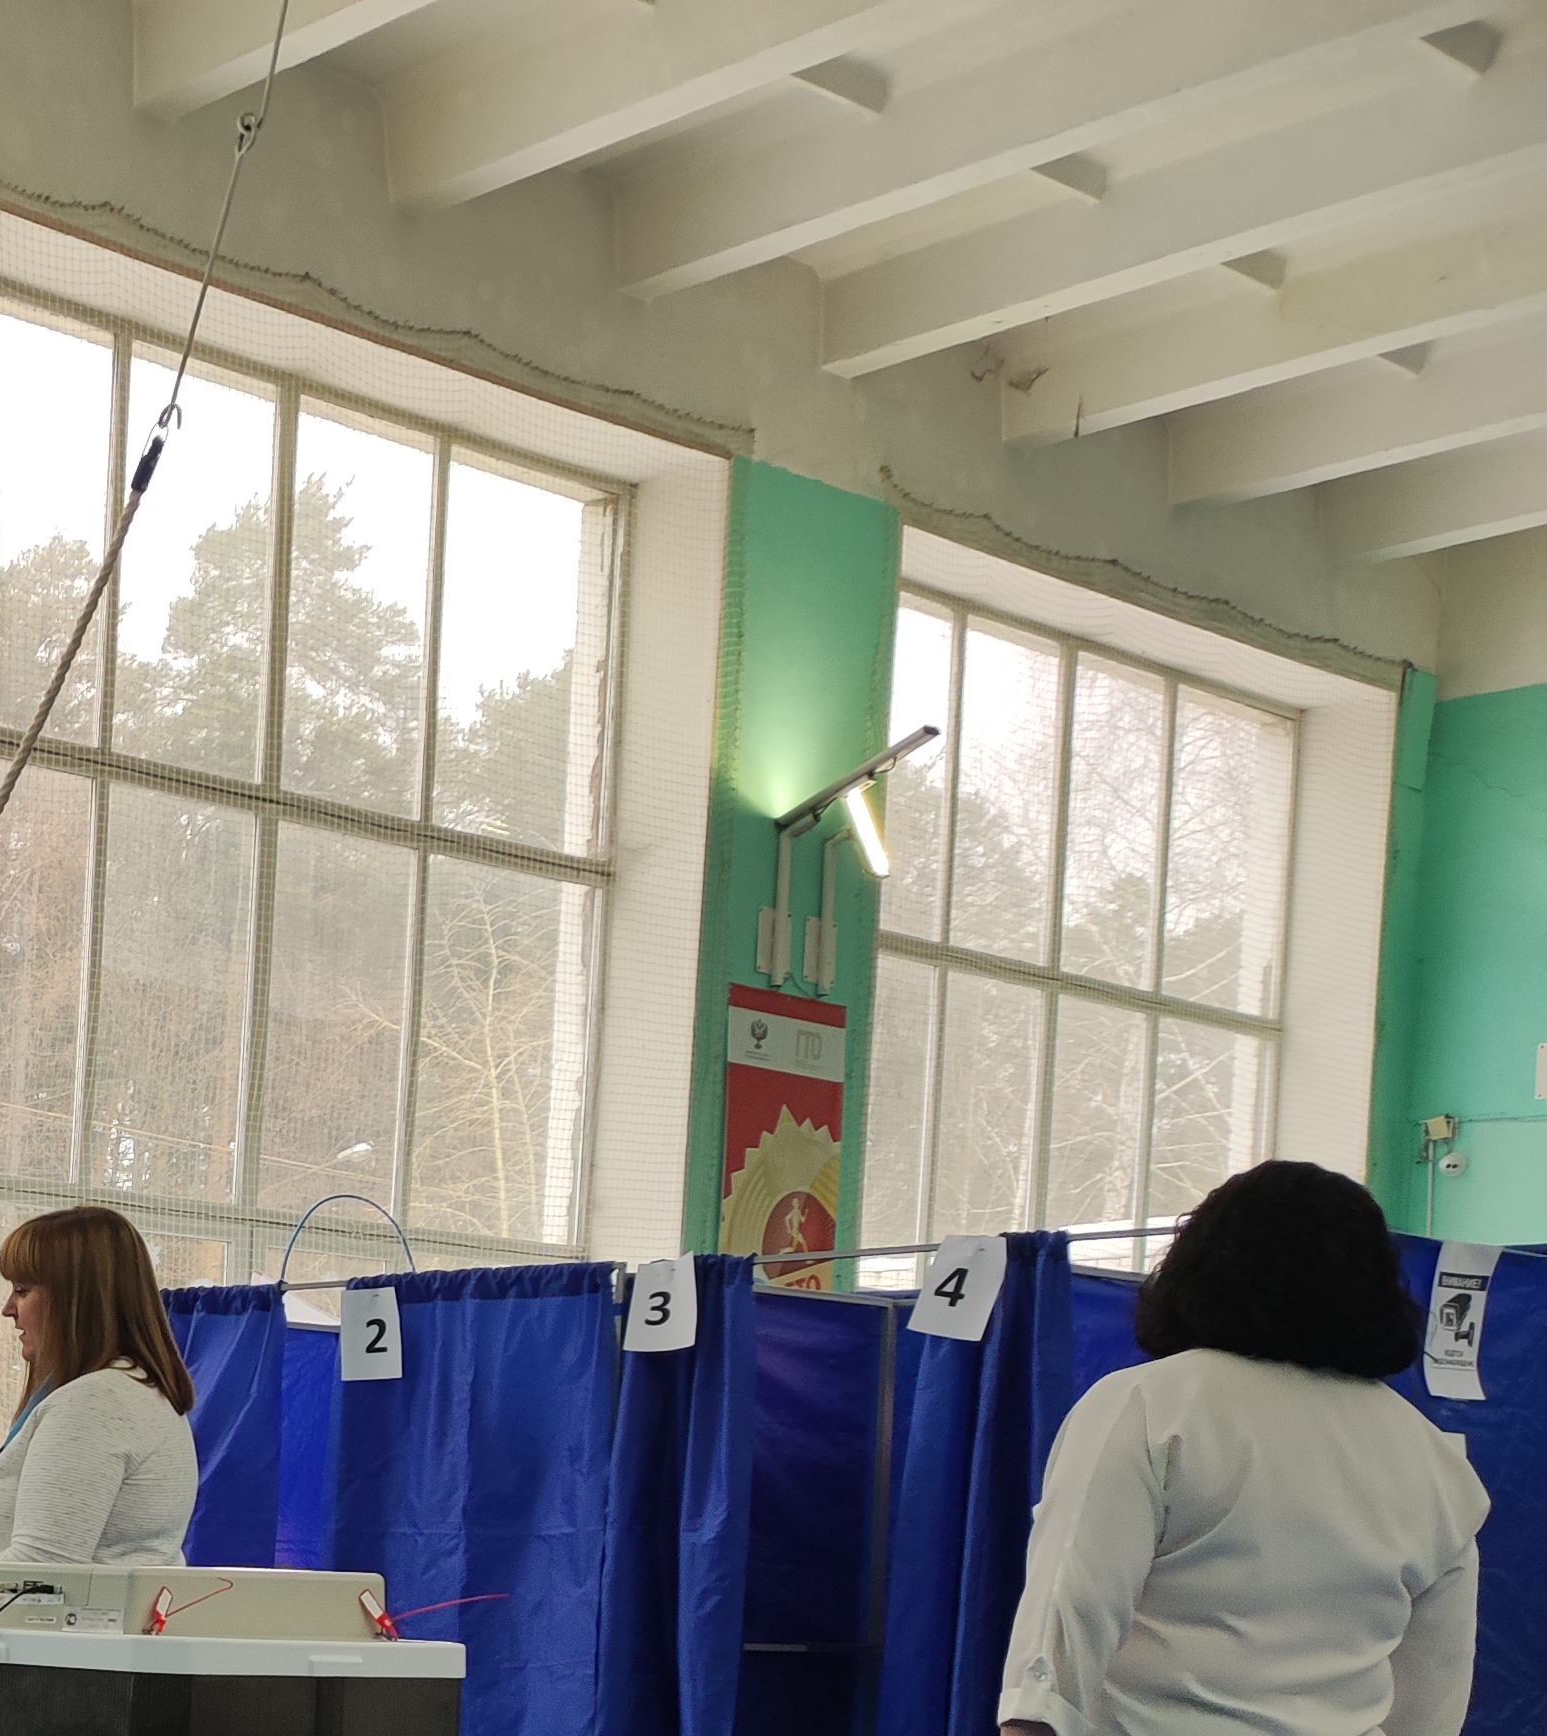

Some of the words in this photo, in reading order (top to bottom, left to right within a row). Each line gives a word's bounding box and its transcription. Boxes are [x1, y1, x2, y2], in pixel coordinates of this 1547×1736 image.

[934, 1268, 968, 1308] 4
[644, 1292, 671, 1325] 3
[365, 1319, 387, 1353] 2
